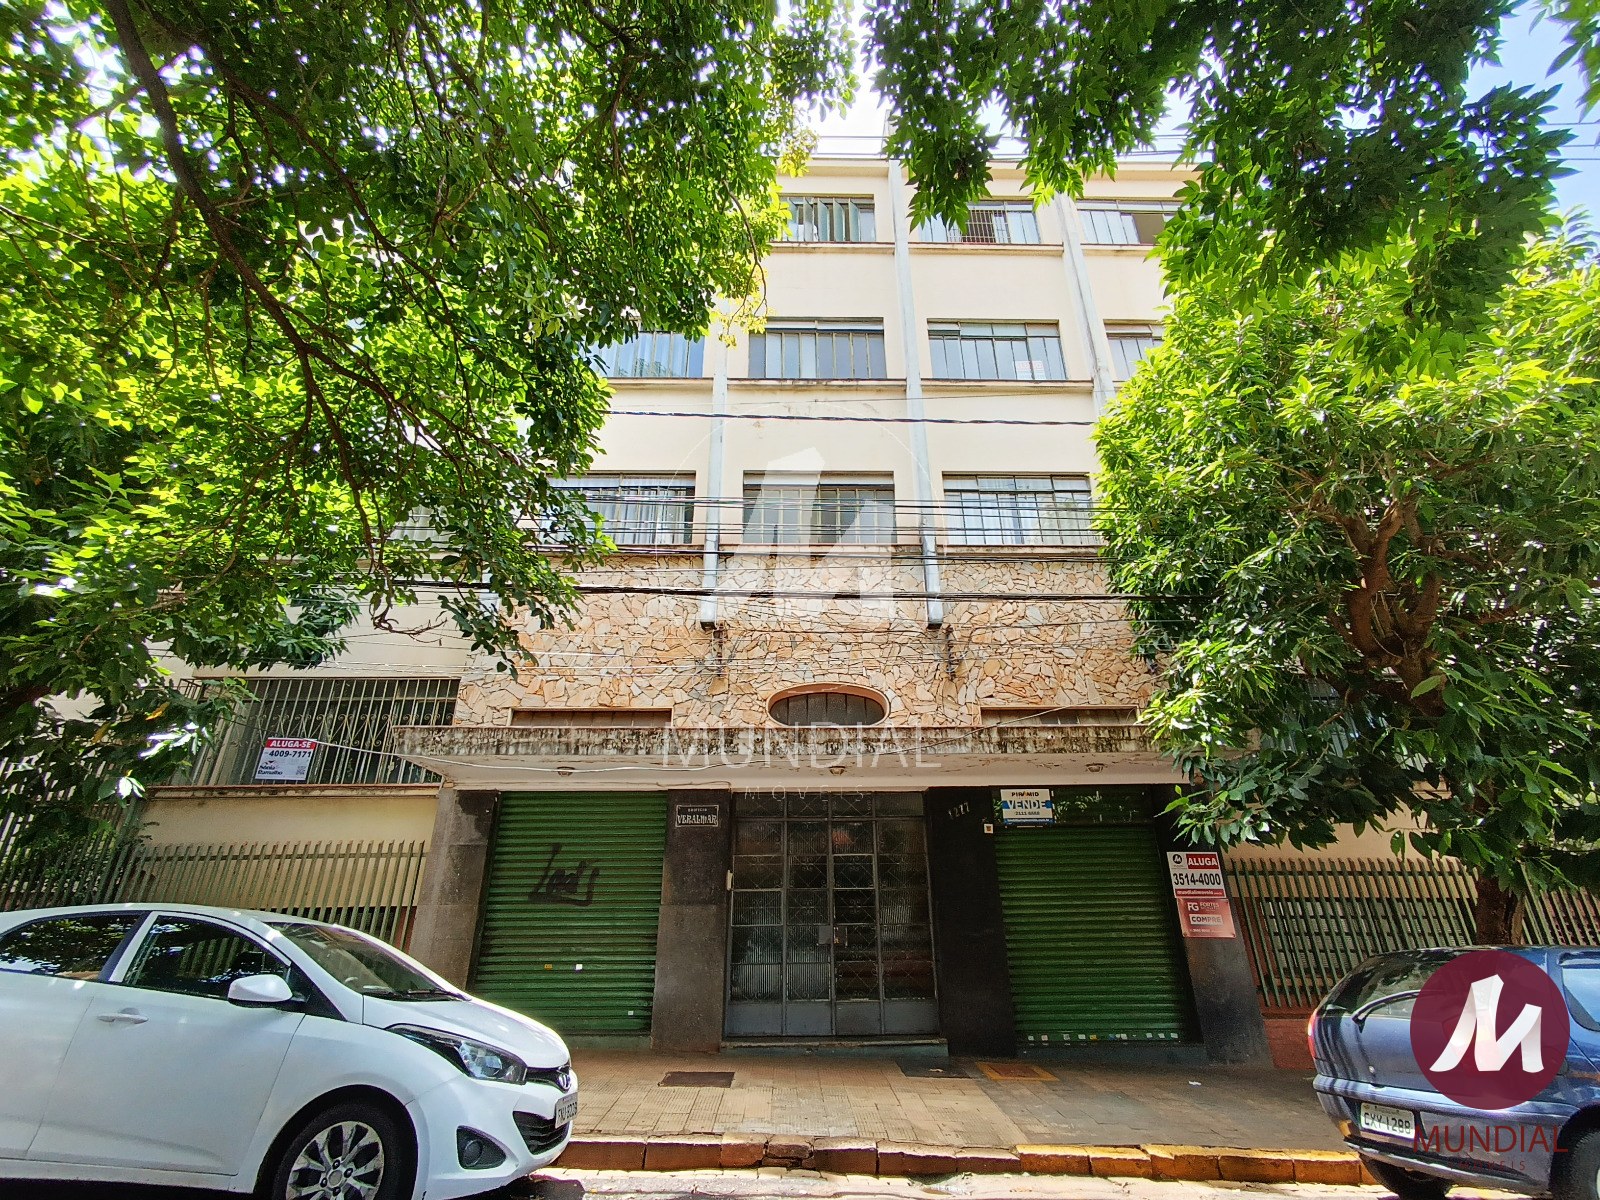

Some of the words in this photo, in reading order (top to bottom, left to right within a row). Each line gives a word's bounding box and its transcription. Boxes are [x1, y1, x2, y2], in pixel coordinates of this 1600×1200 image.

[1007, 800, 1045, 809] VENDE
[1188, 858, 1217, 866] ALUGA
[1172, 872, 1221, 886] 3514-4000
